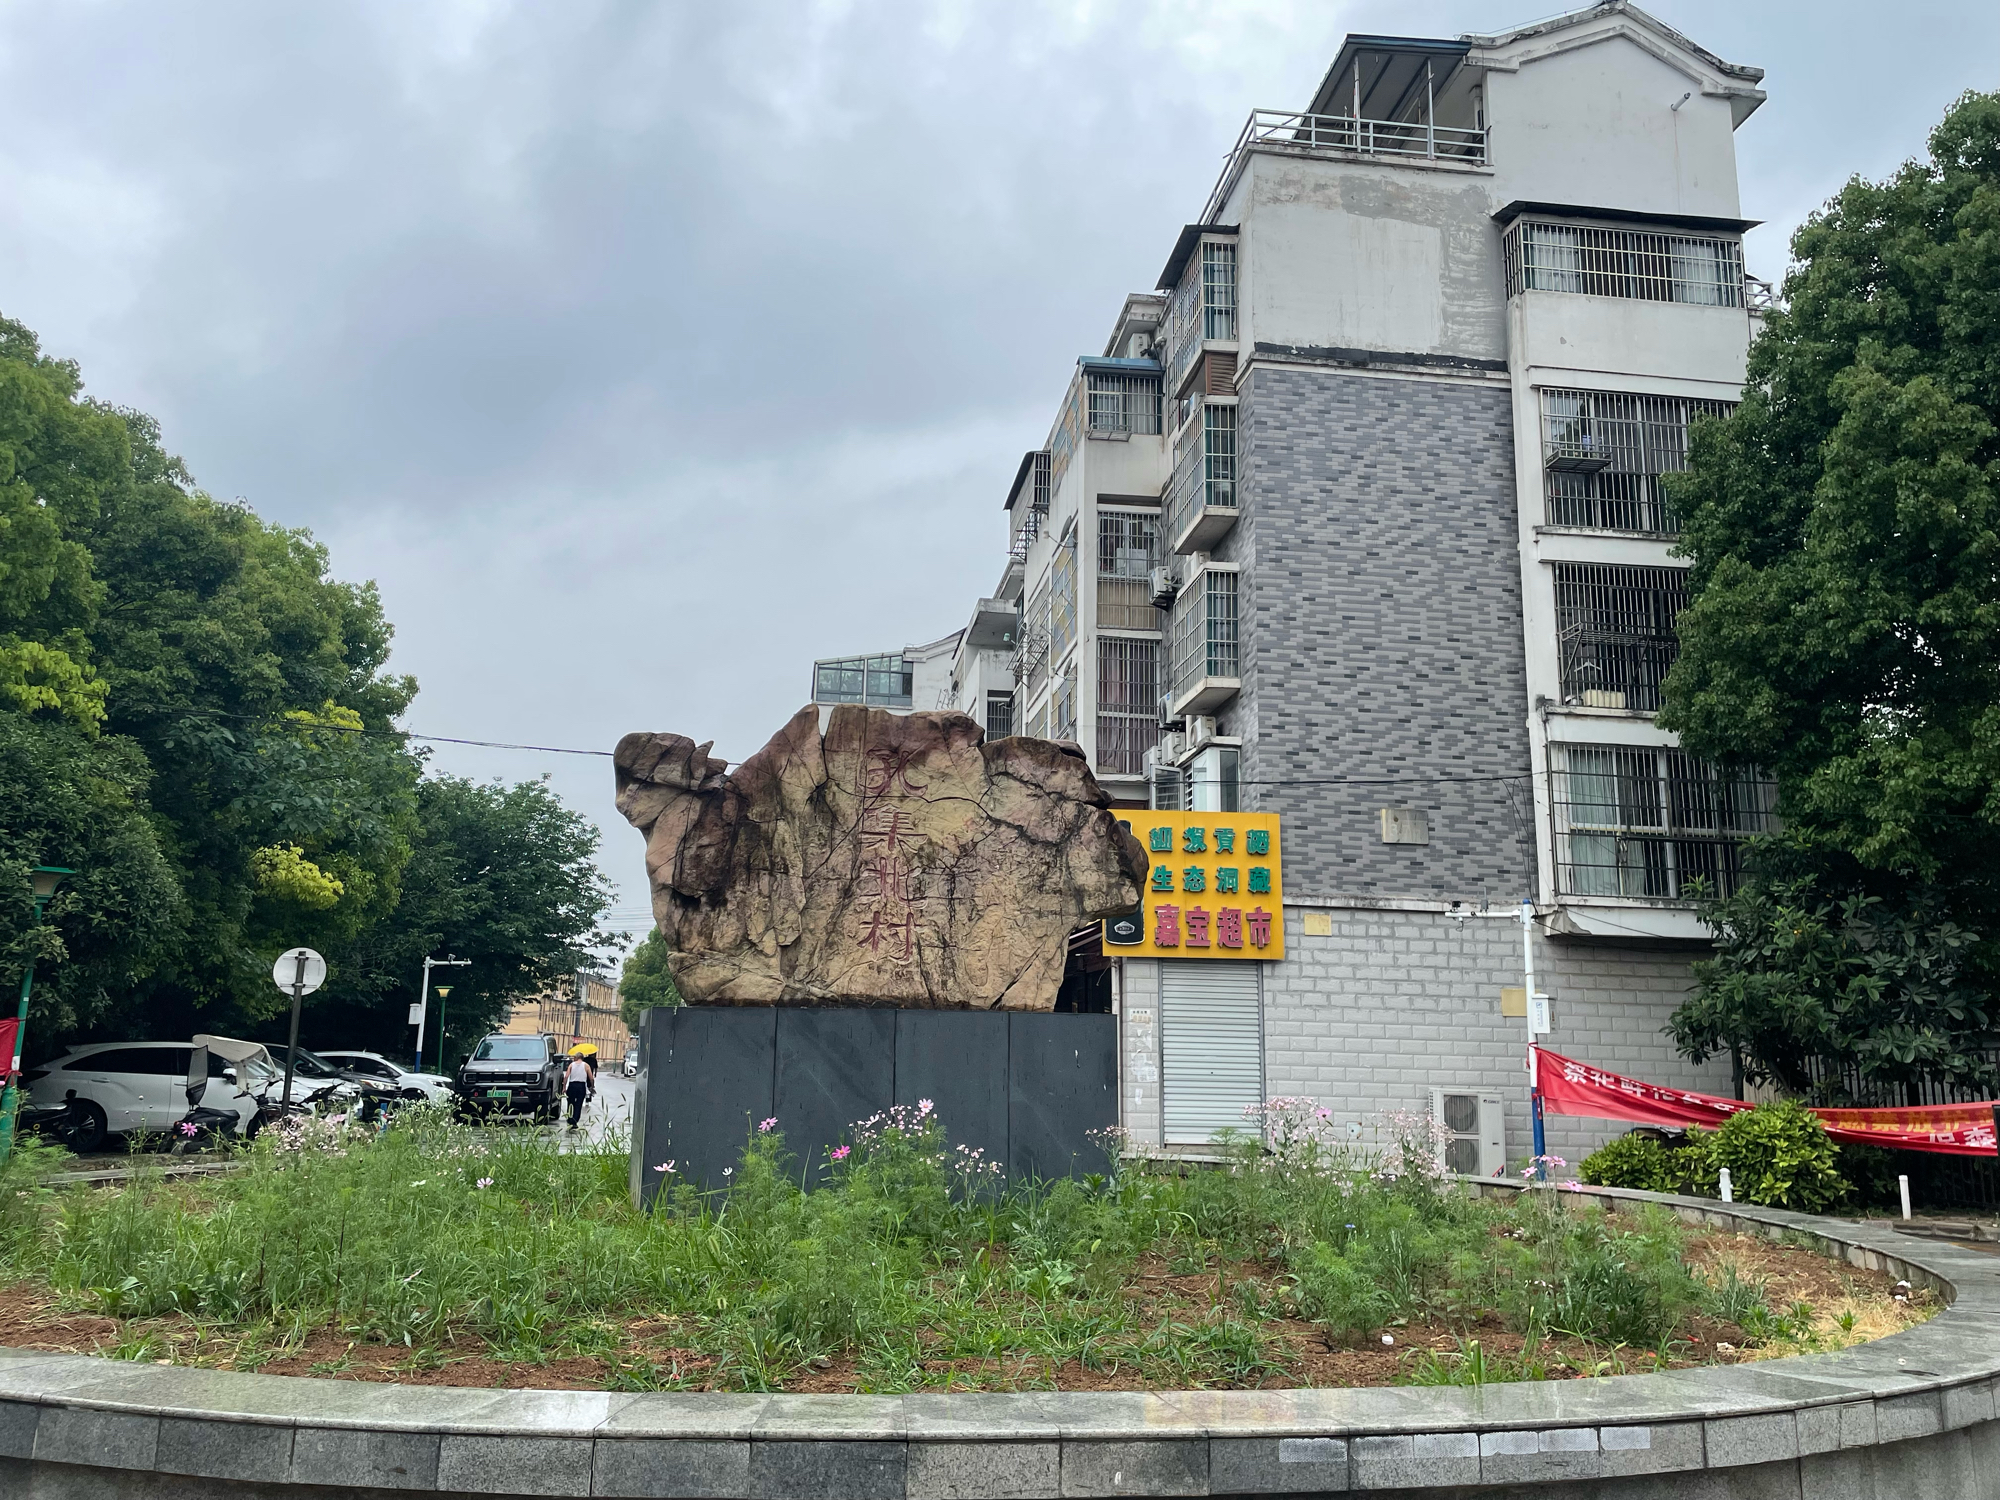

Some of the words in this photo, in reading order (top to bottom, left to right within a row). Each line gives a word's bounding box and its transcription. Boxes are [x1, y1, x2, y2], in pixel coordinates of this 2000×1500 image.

[1152, 864, 1272, 893] 生态洞藏
[1155, 904, 1273, 948] 嘉宝超市
